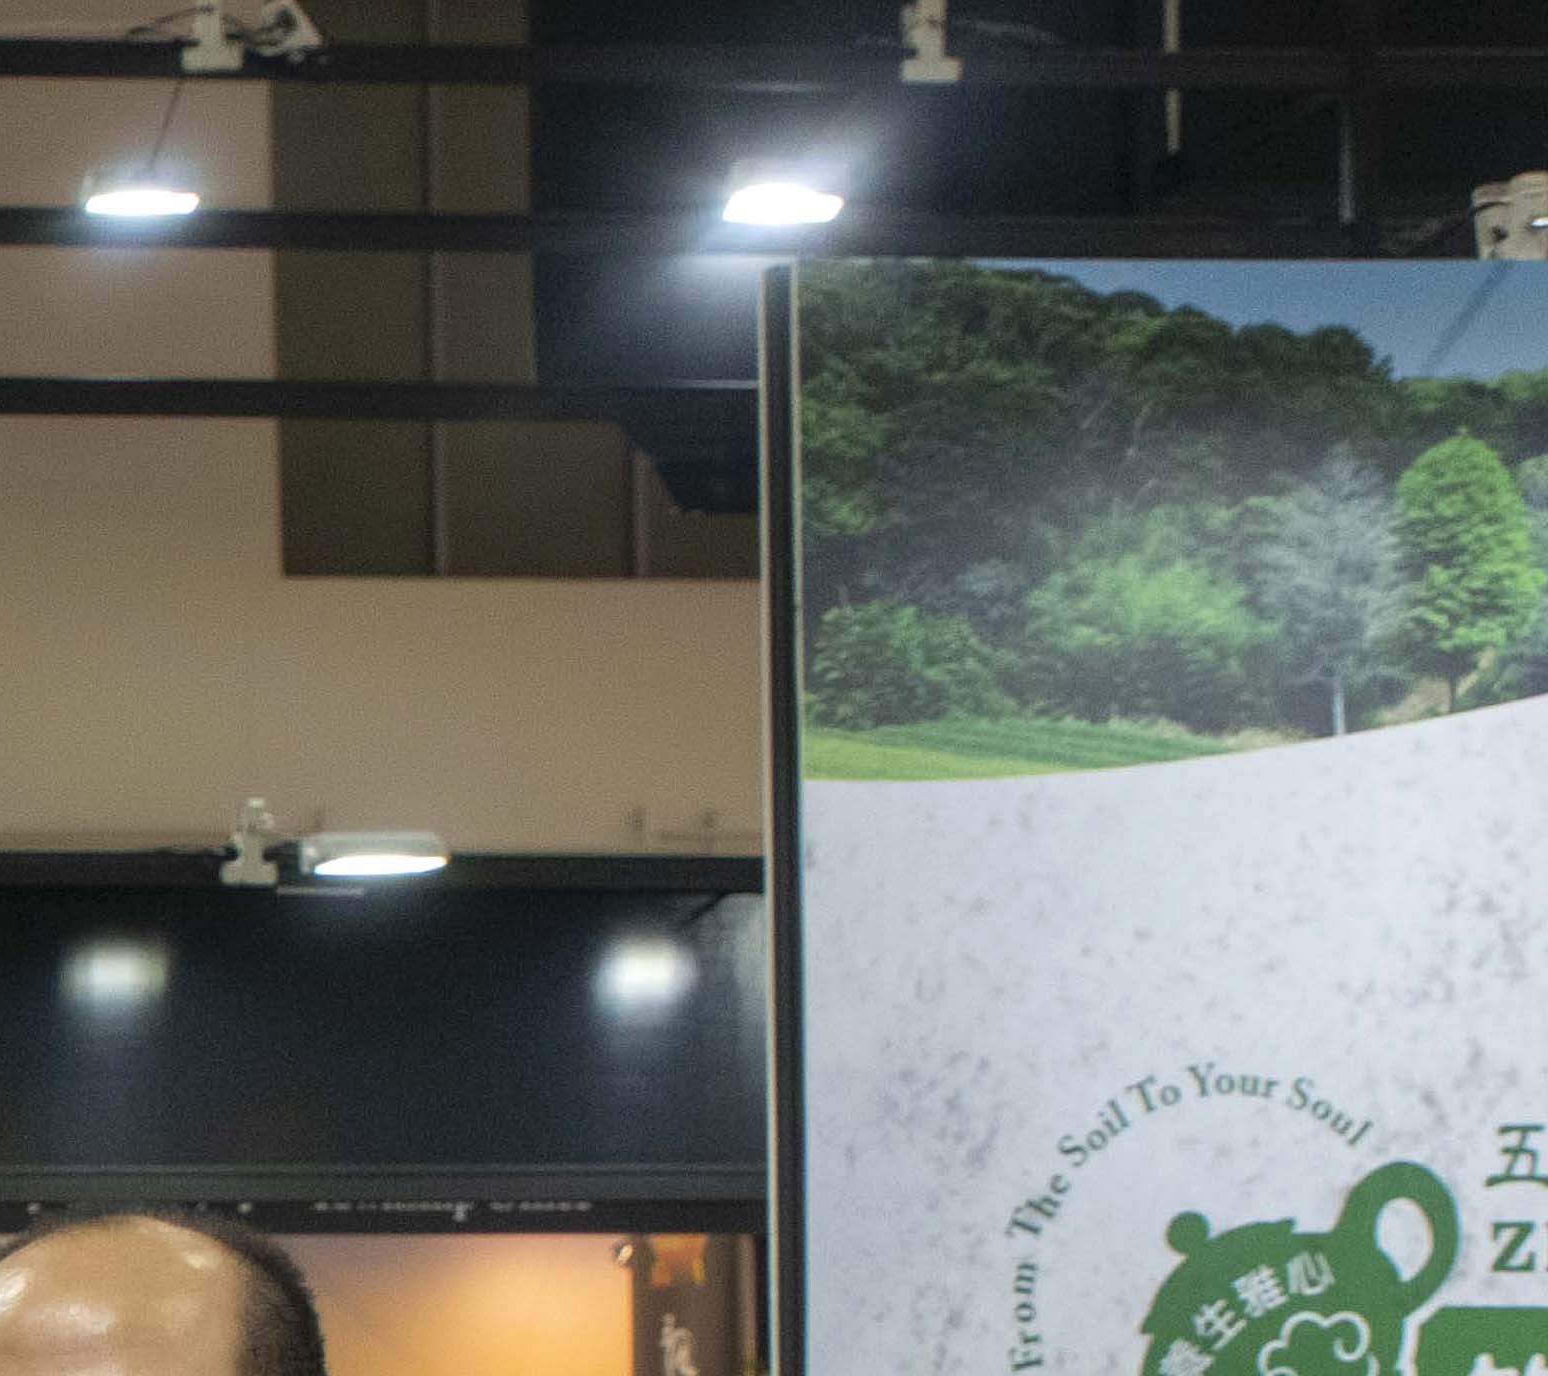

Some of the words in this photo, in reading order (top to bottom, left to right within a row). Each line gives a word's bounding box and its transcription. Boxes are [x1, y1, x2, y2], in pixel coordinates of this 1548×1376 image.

[1126, 1076, 1183, 1116] To
[1187, 1063, 1279, 1100] Your
[1286, 1077, 1375, 1147] Soul
[1056, 1100, 1131, 1168] Soil
[1006, 1172, 1072, 1244] The
[1010, 1258, 1043, 1373] From
